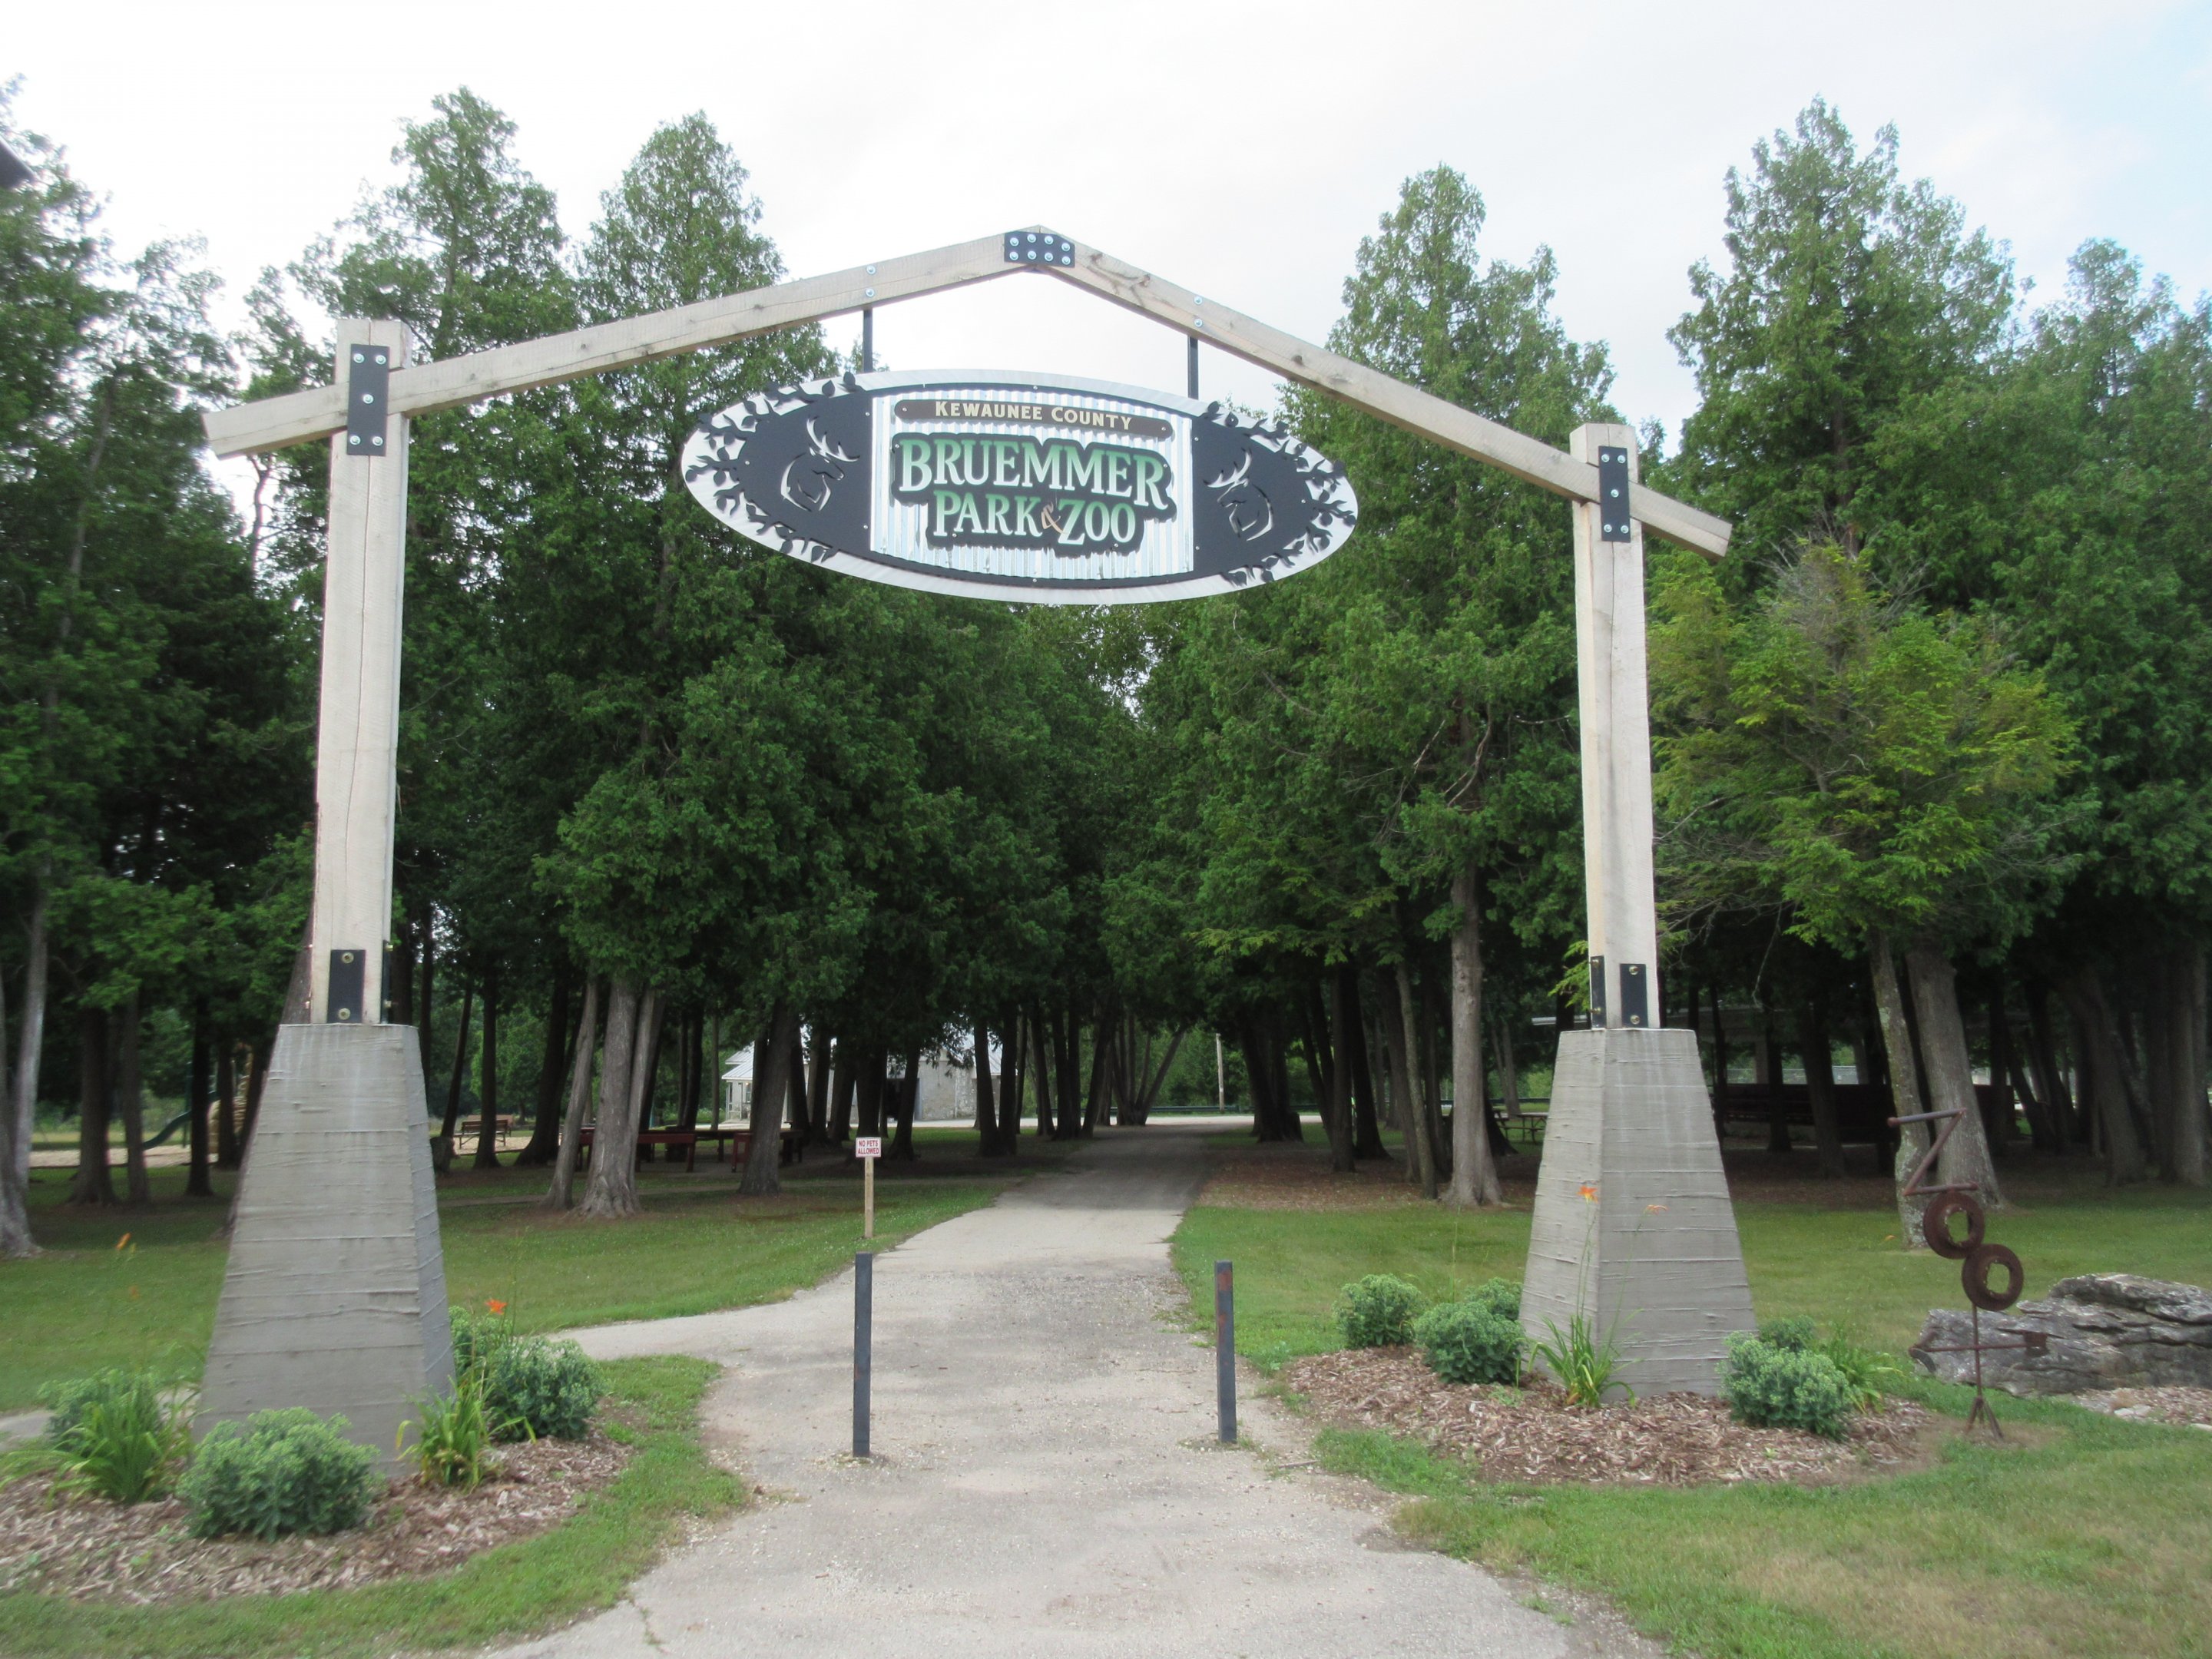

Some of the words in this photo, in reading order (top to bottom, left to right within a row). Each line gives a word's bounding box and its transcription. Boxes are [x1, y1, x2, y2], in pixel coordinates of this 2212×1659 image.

[935, 401, 1043, 421] KEWAUNEE
[1051, 406, 1133, 430] COUNTY
[899, 439, 1169, 510] BRUEMMER
[933, 489, 1043, 537] PARK
[1041, 502, 1068, 534] &
[1057, 498, 1137, 545] ZOO
